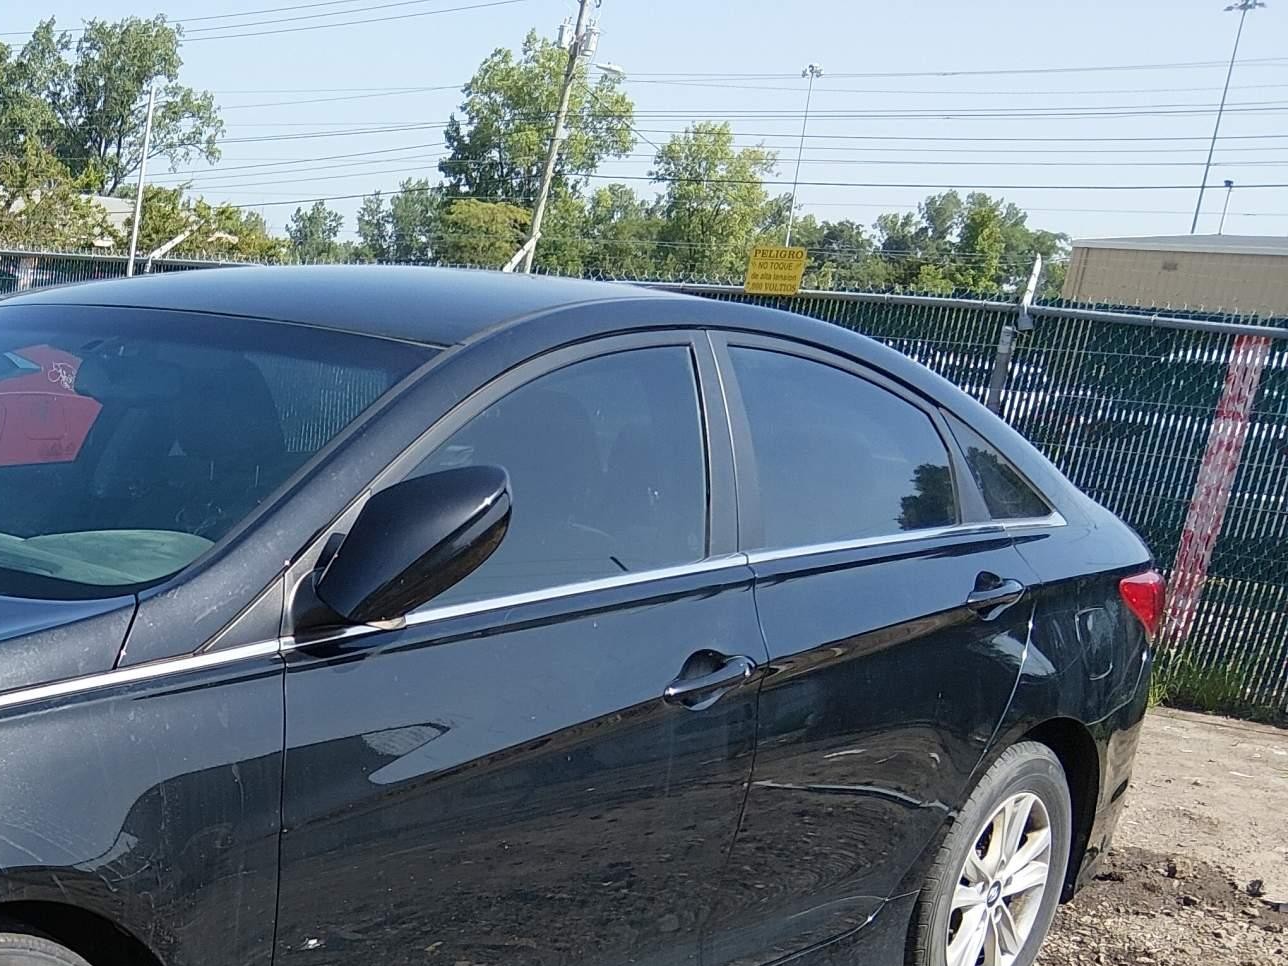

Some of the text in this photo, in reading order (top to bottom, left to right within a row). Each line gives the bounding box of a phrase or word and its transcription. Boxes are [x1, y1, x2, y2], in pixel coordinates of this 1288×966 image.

[753, 249, 804, 259] PELIGRO
[758, 262, 793, 271] NO TOQUE
[765, 282, 797, 292] VOLTIOS
